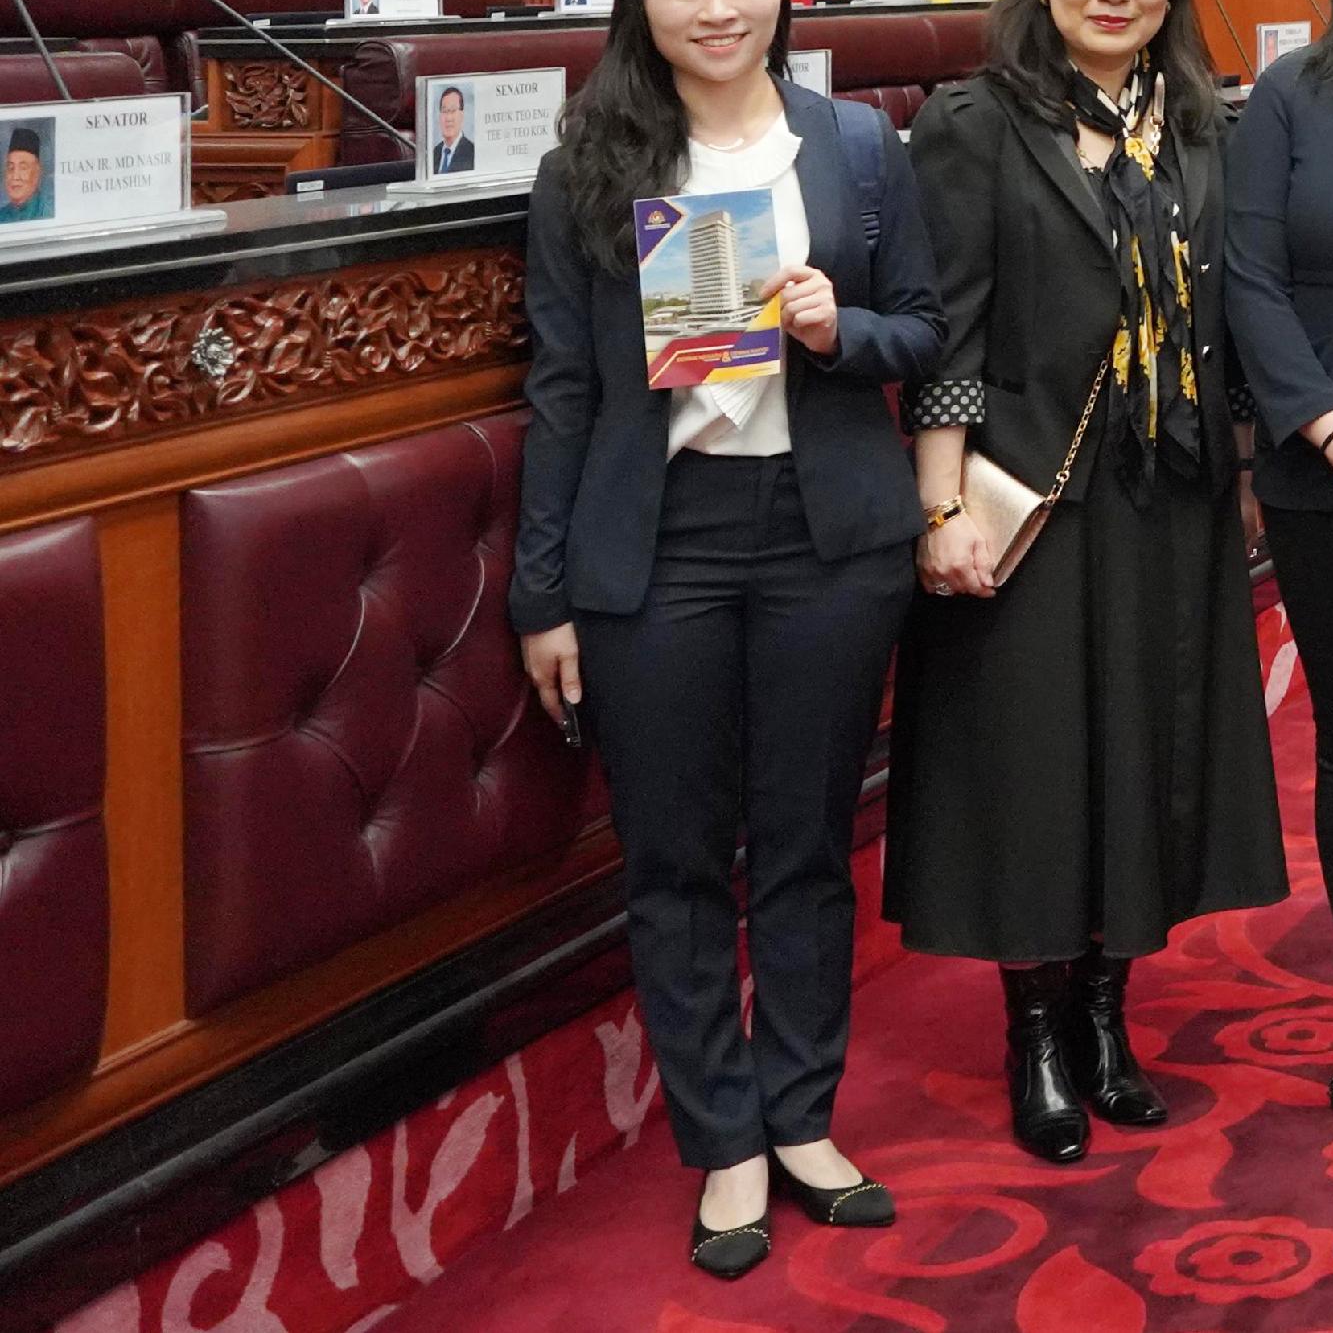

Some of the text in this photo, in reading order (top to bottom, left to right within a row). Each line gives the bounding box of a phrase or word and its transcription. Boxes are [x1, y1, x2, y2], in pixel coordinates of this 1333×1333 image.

[495, 82, 538, 96] SENATOR
[85, 112, 148, 129] SENATOR
[484, 108, 550, 124] DATUK TEO ENG
[60, 159, 94, 174] TUAN
[115, 156, 134, 169] MD
[138, 152, 172, 166] NASIR
[81, 175, 152, 194] BIN HASHIM
